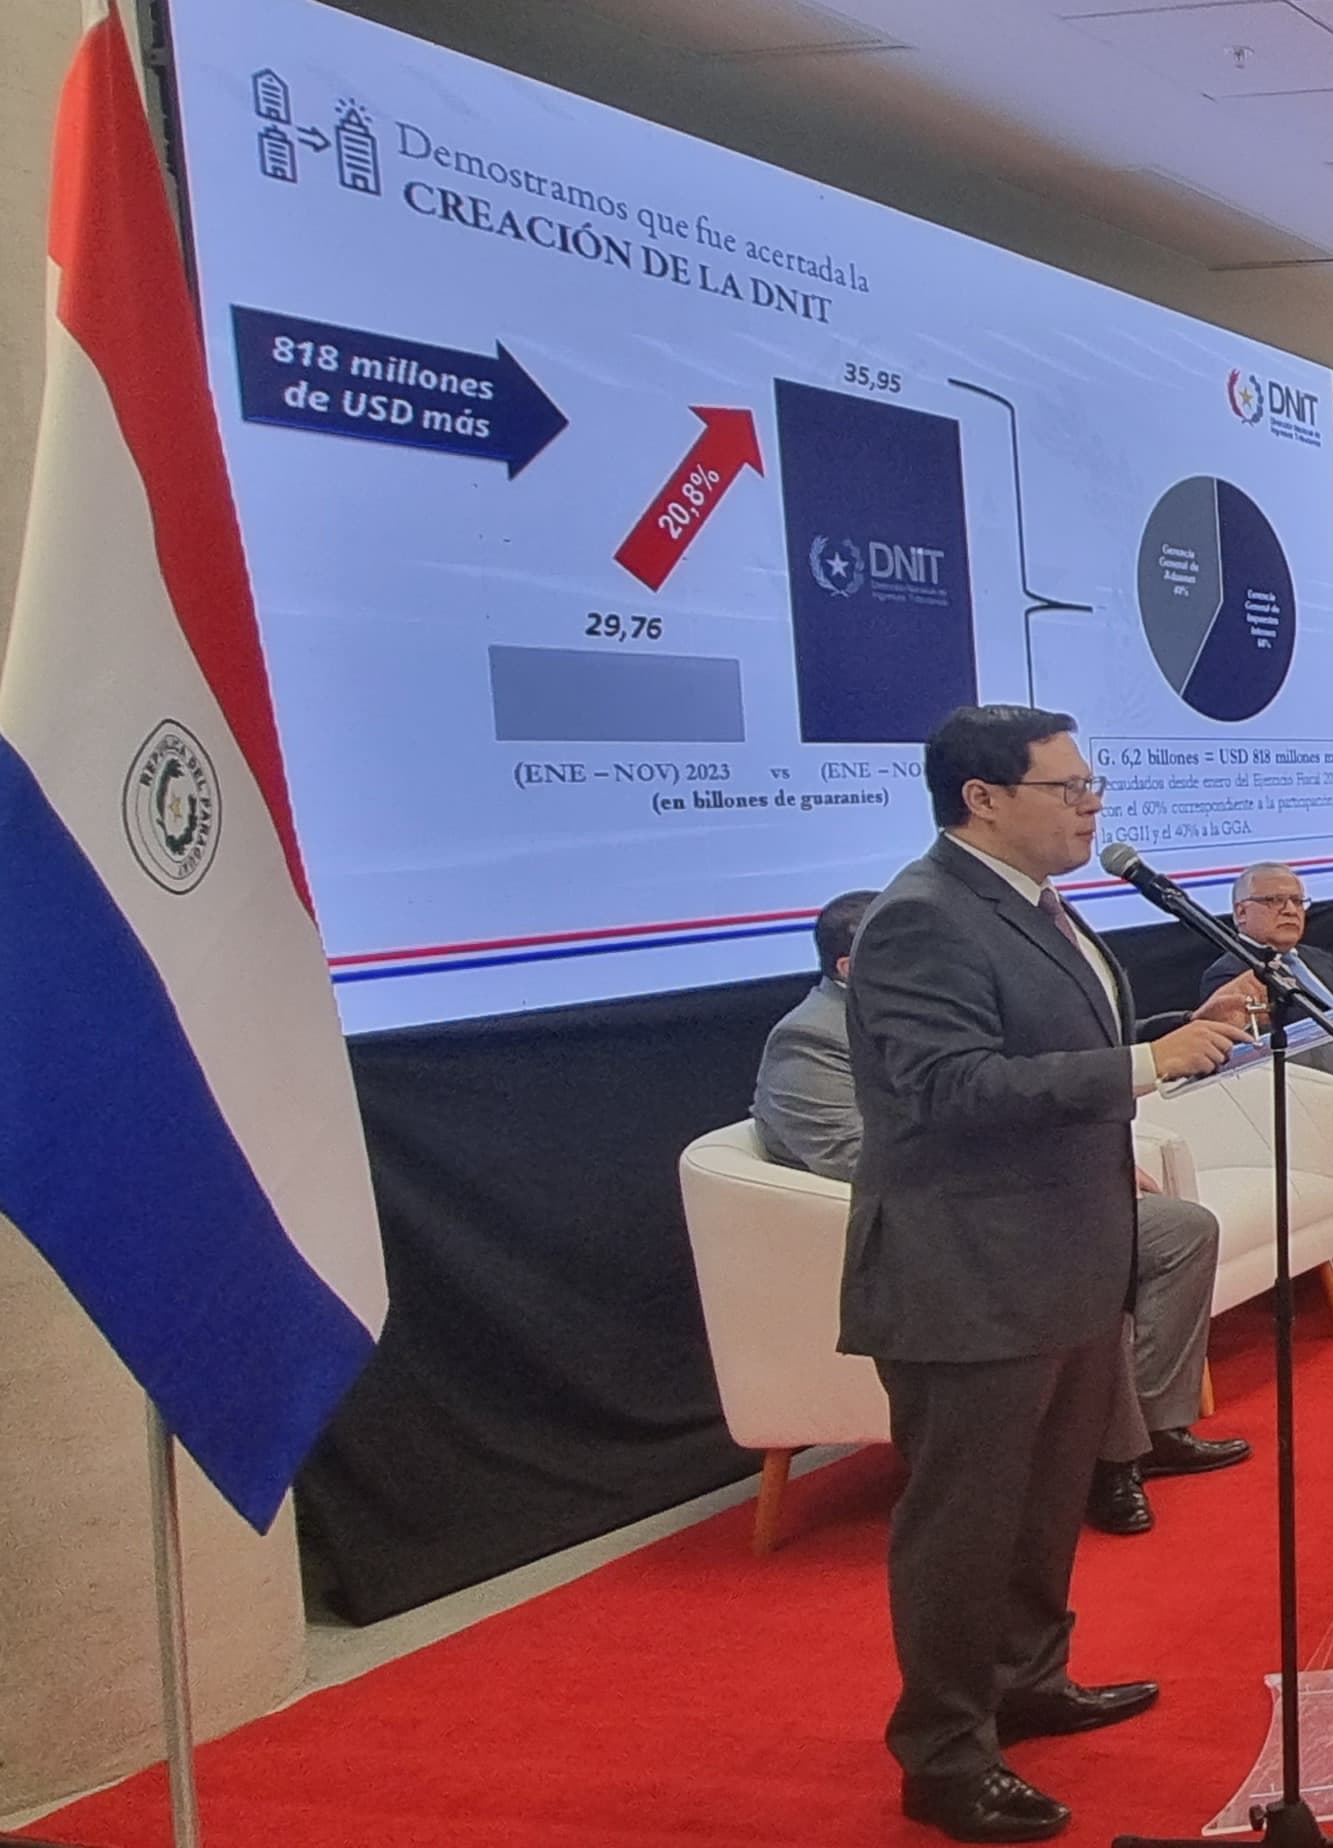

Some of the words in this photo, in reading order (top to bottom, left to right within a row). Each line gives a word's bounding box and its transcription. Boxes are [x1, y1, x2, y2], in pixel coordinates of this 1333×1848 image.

[395, 121, 628, 220] Demostramos
[637, 208, 688, 239] que
[696, 215, 736, 252] fue
[746, 241, 846, 287] acertada
[850, 263, 869, 292] la
[404, 181, 632, 269] CREACIÓN
[641, 245, 691, 285] DE
[699, 263, 744, 300] LA
[750, 277, 832, 323] DNIT
[272, 336, 339, 371] 818
[350, 356, 494, 400] millones
[844, 362, 901, 393] 35,95
[283, 380, 330, 412] de
[343, 390, 413, 425] USD
[423, 409, 490, 438] más
[1269, 381, 1318, 426] DNIT
[659, 464, 719, 539] 20,8%
[869, 542, 944, 584] DNIT
[585, 612, 662, 642] 29,76
[514, 761, 586, 790] (ENE
[614, 763, 679, 786] NOV)
[686, 763, 730, 780] 2023
[770, 768, 790, 779] vs
[821, 762, 871, 782] (ENE
[892, 762, 921, 778] NO
[1098, 748, 1115, 765] G.
[1121, 748, 1142, 768] 6,2
[1148, 748, 1199, 765] billones
[1219, 748, 1248, 764] USD
[1253, 748, 1271, 764] 818
[1275, 749, 1320, 764] millones
[1105, 775, 1164, 791] ecaudados
[652, 792, 685, 815] (en
[693, 790, 768, 808] billones
[774, 789, 796, 806] de
[1101, 806, 1122, 817] con
[1127, 800, 1137, 816] el
